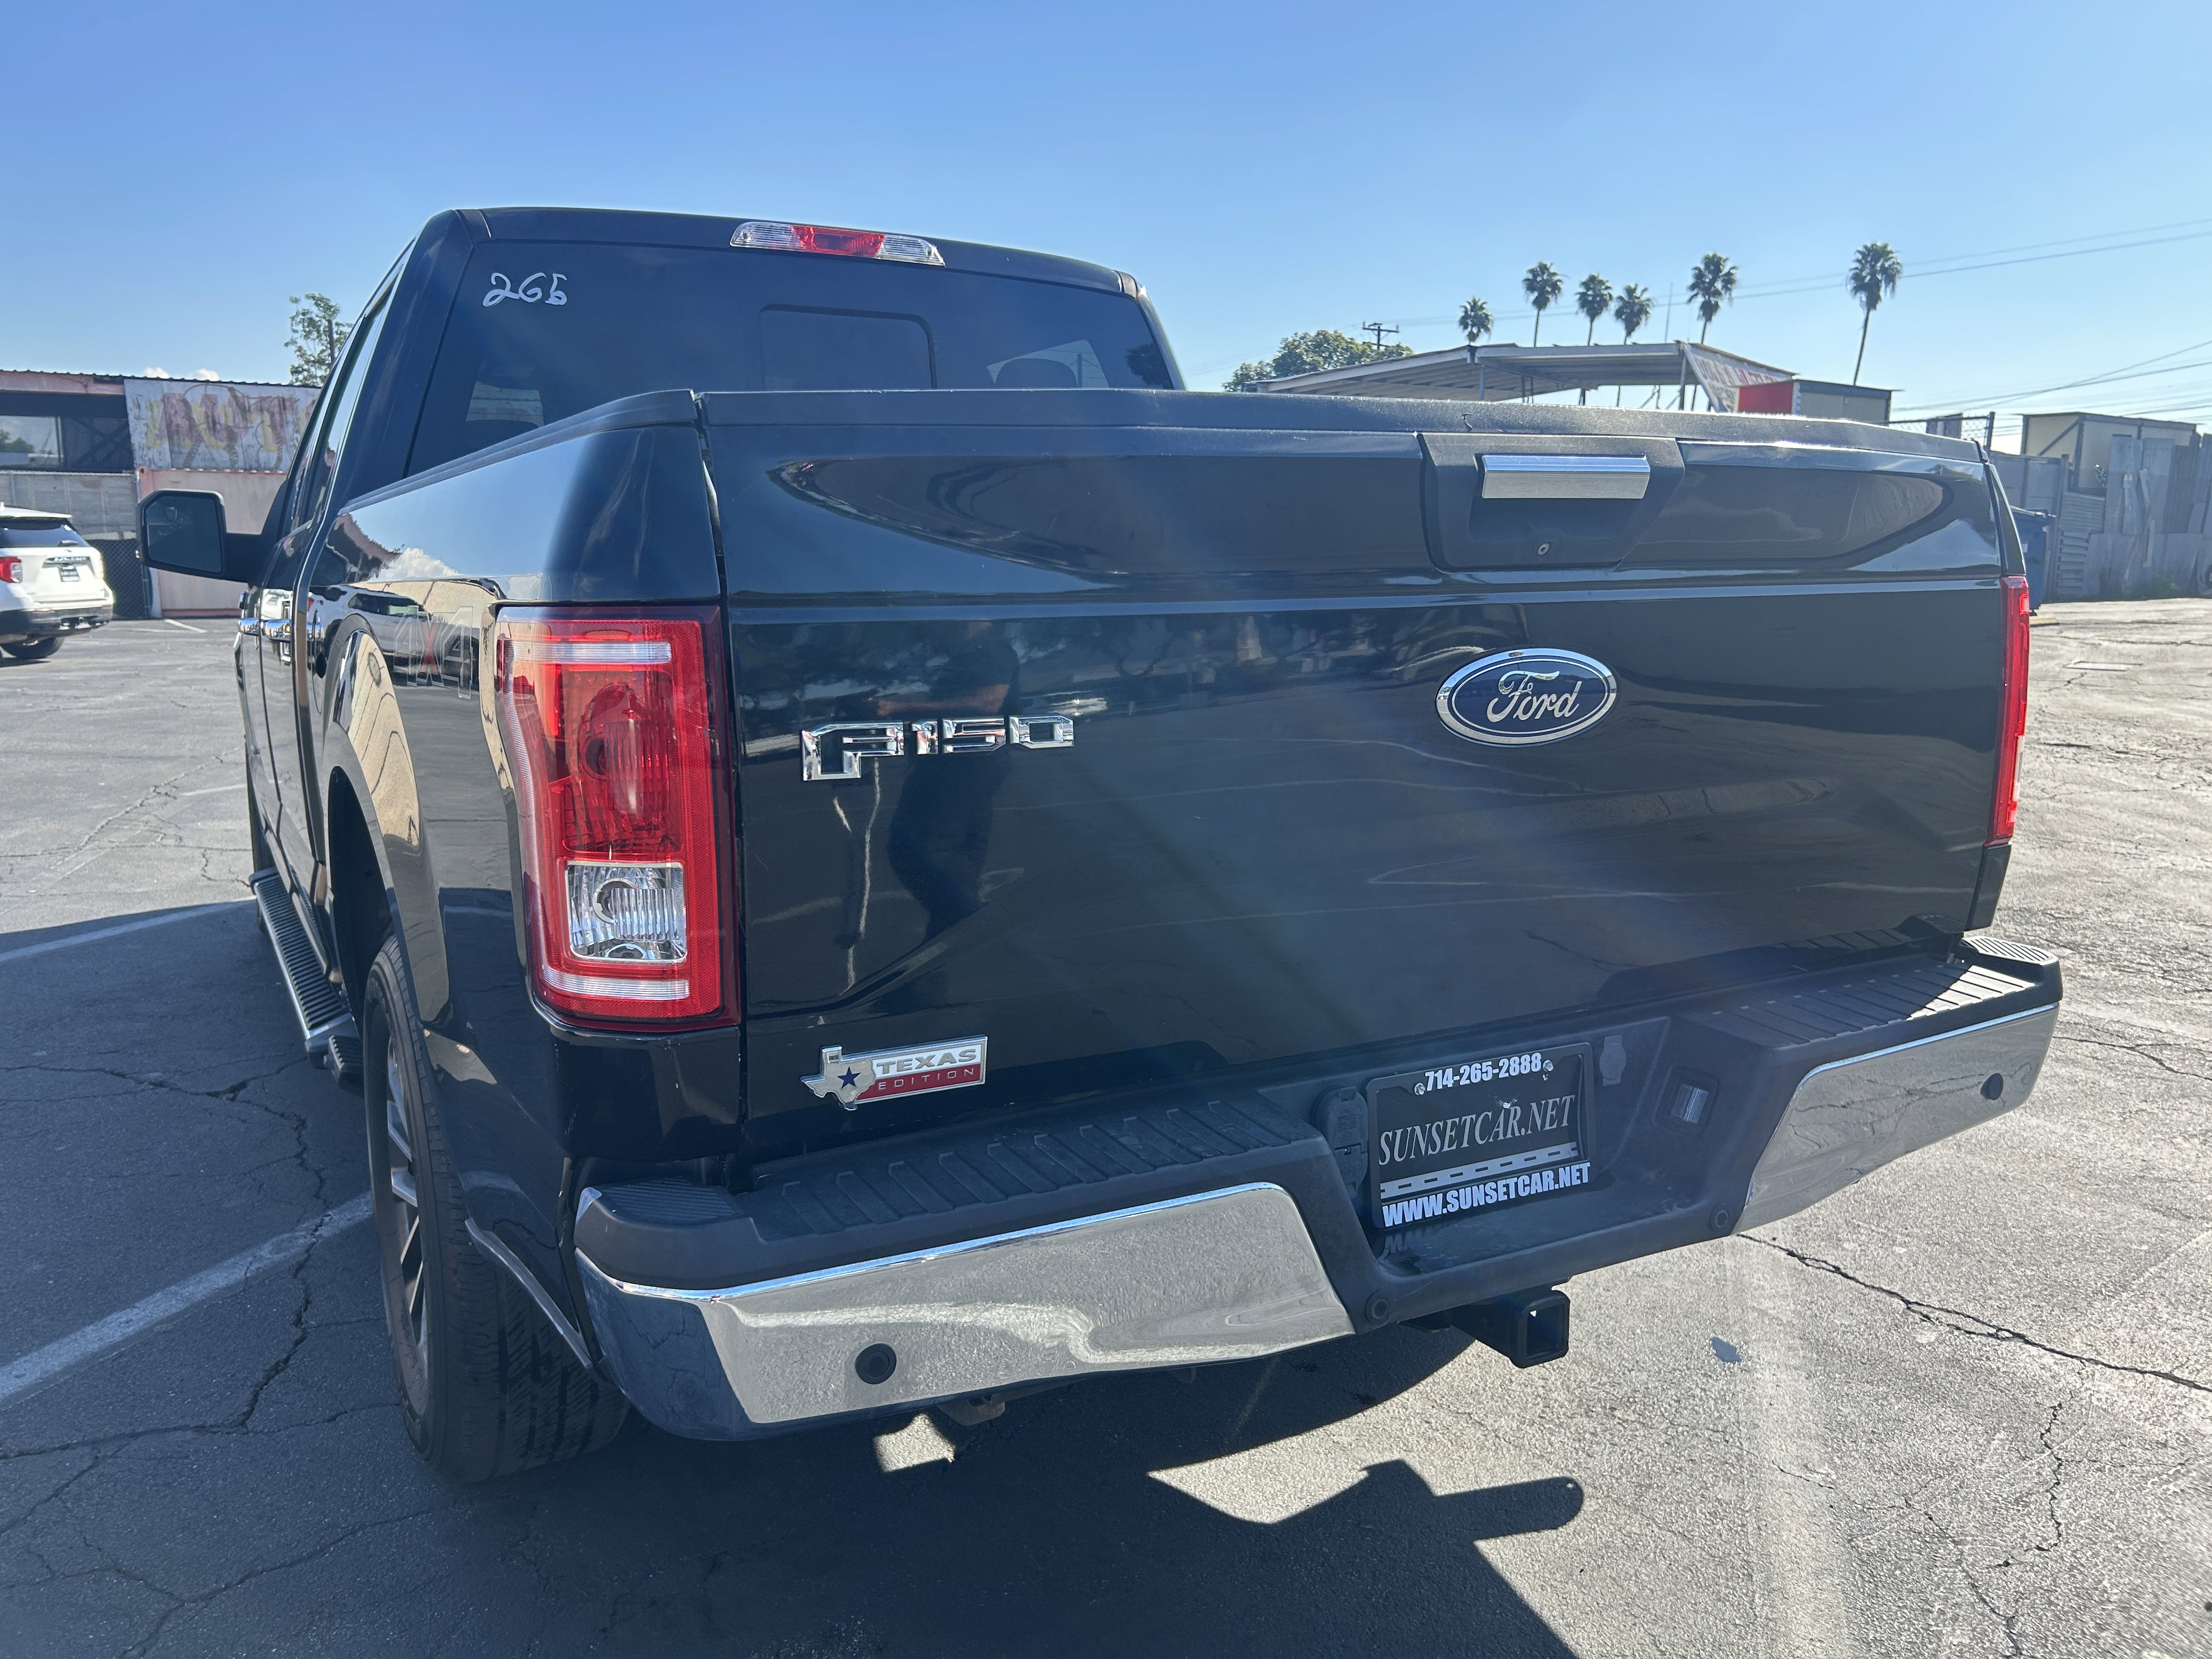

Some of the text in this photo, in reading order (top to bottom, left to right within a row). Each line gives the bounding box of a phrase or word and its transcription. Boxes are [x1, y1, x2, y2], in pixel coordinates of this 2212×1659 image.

[483, 272, 567, 307] 265
[1487, 670, 1582, 723] Ford
[802, 715, 1074, 781] F150
[876, 1048, 977, 1074] TEXAS
[878, 1068, 974, 1090] EDITION
[1425, 1052, 1542, 1091] 714-265-2888
[1379, 1094, 1575, 1165] SUNSETCAR.NET
[1382, 1162, 1590, 1227] WWW.SUNSETCAR.NET
